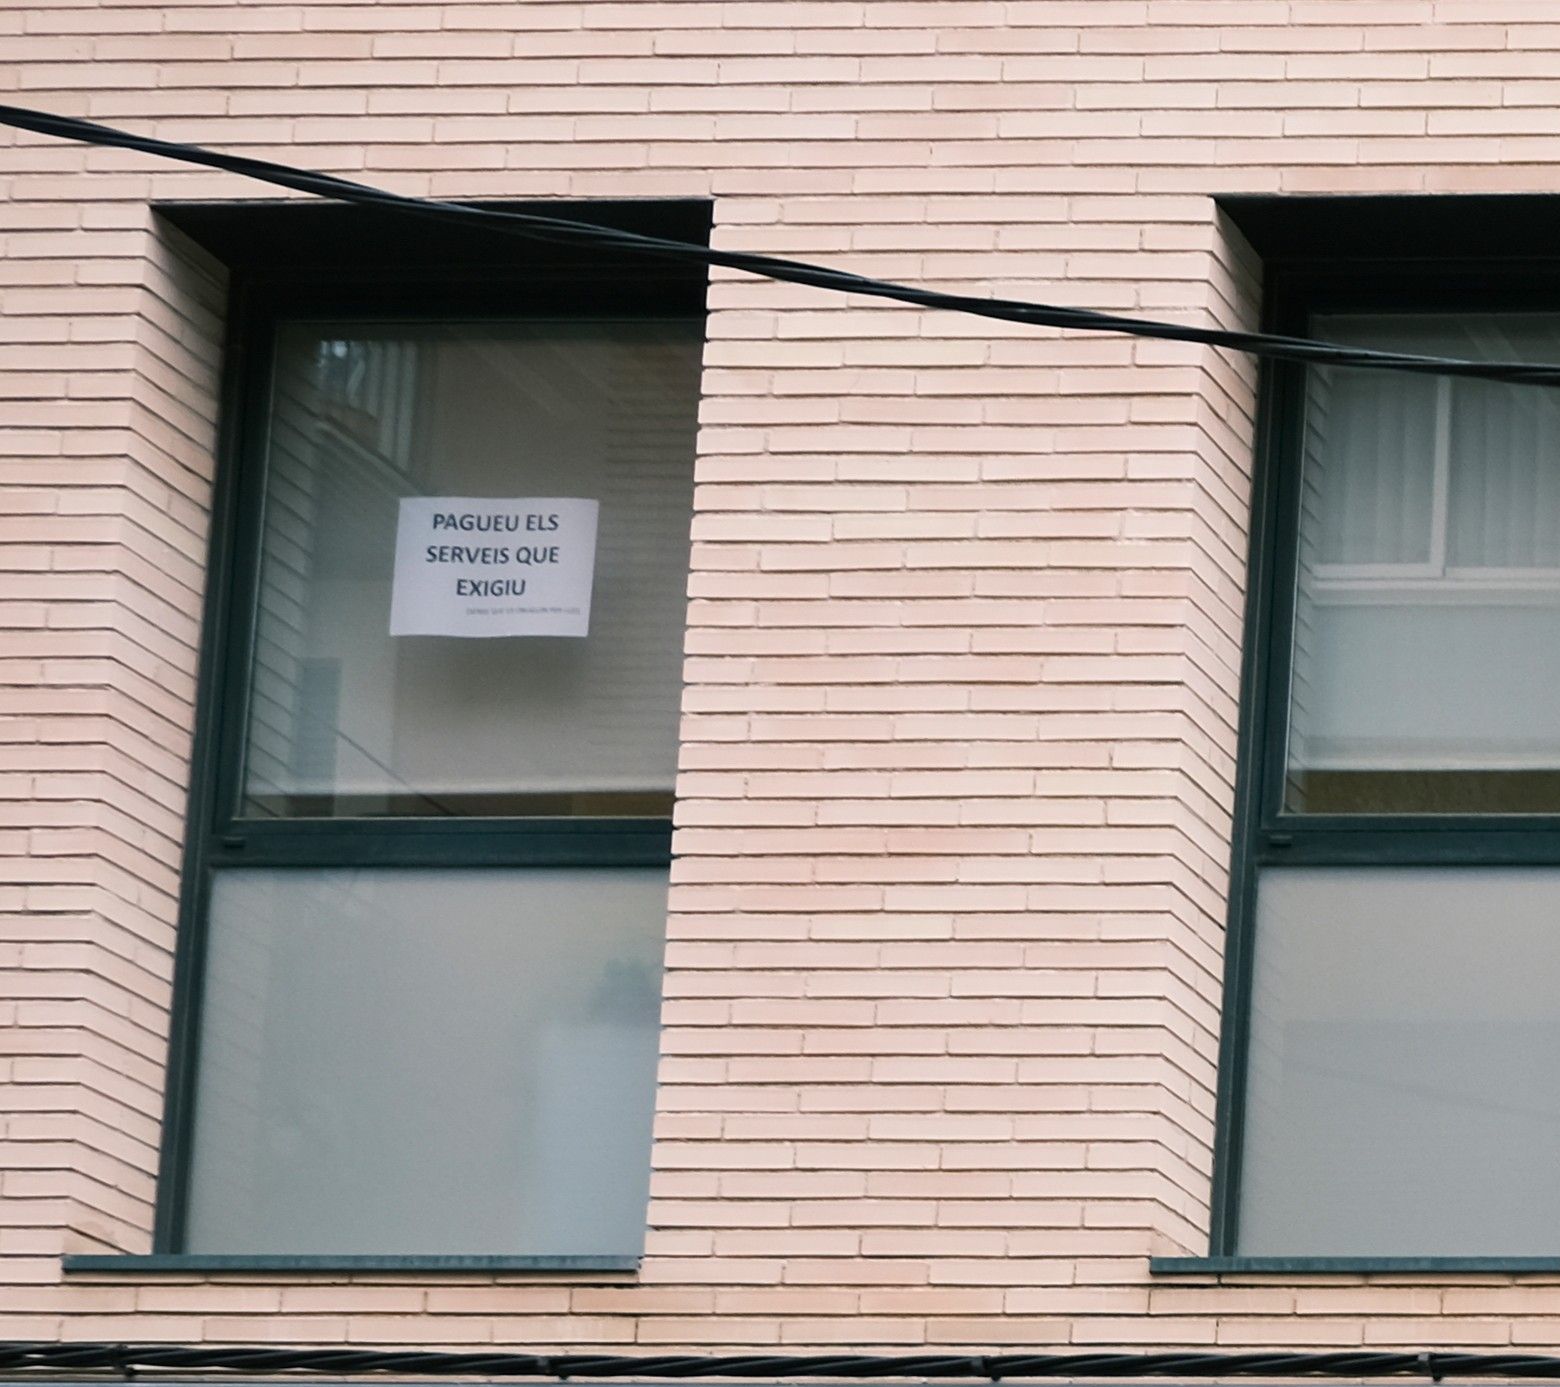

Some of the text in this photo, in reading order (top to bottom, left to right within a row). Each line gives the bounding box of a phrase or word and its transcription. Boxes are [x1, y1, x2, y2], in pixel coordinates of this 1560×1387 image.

[433, 514, 559, 531] PAGUEU ELS
[426, 546, 559, 565] SERVEIS QUE
[457, 579, 526, 596] EXIGIU
